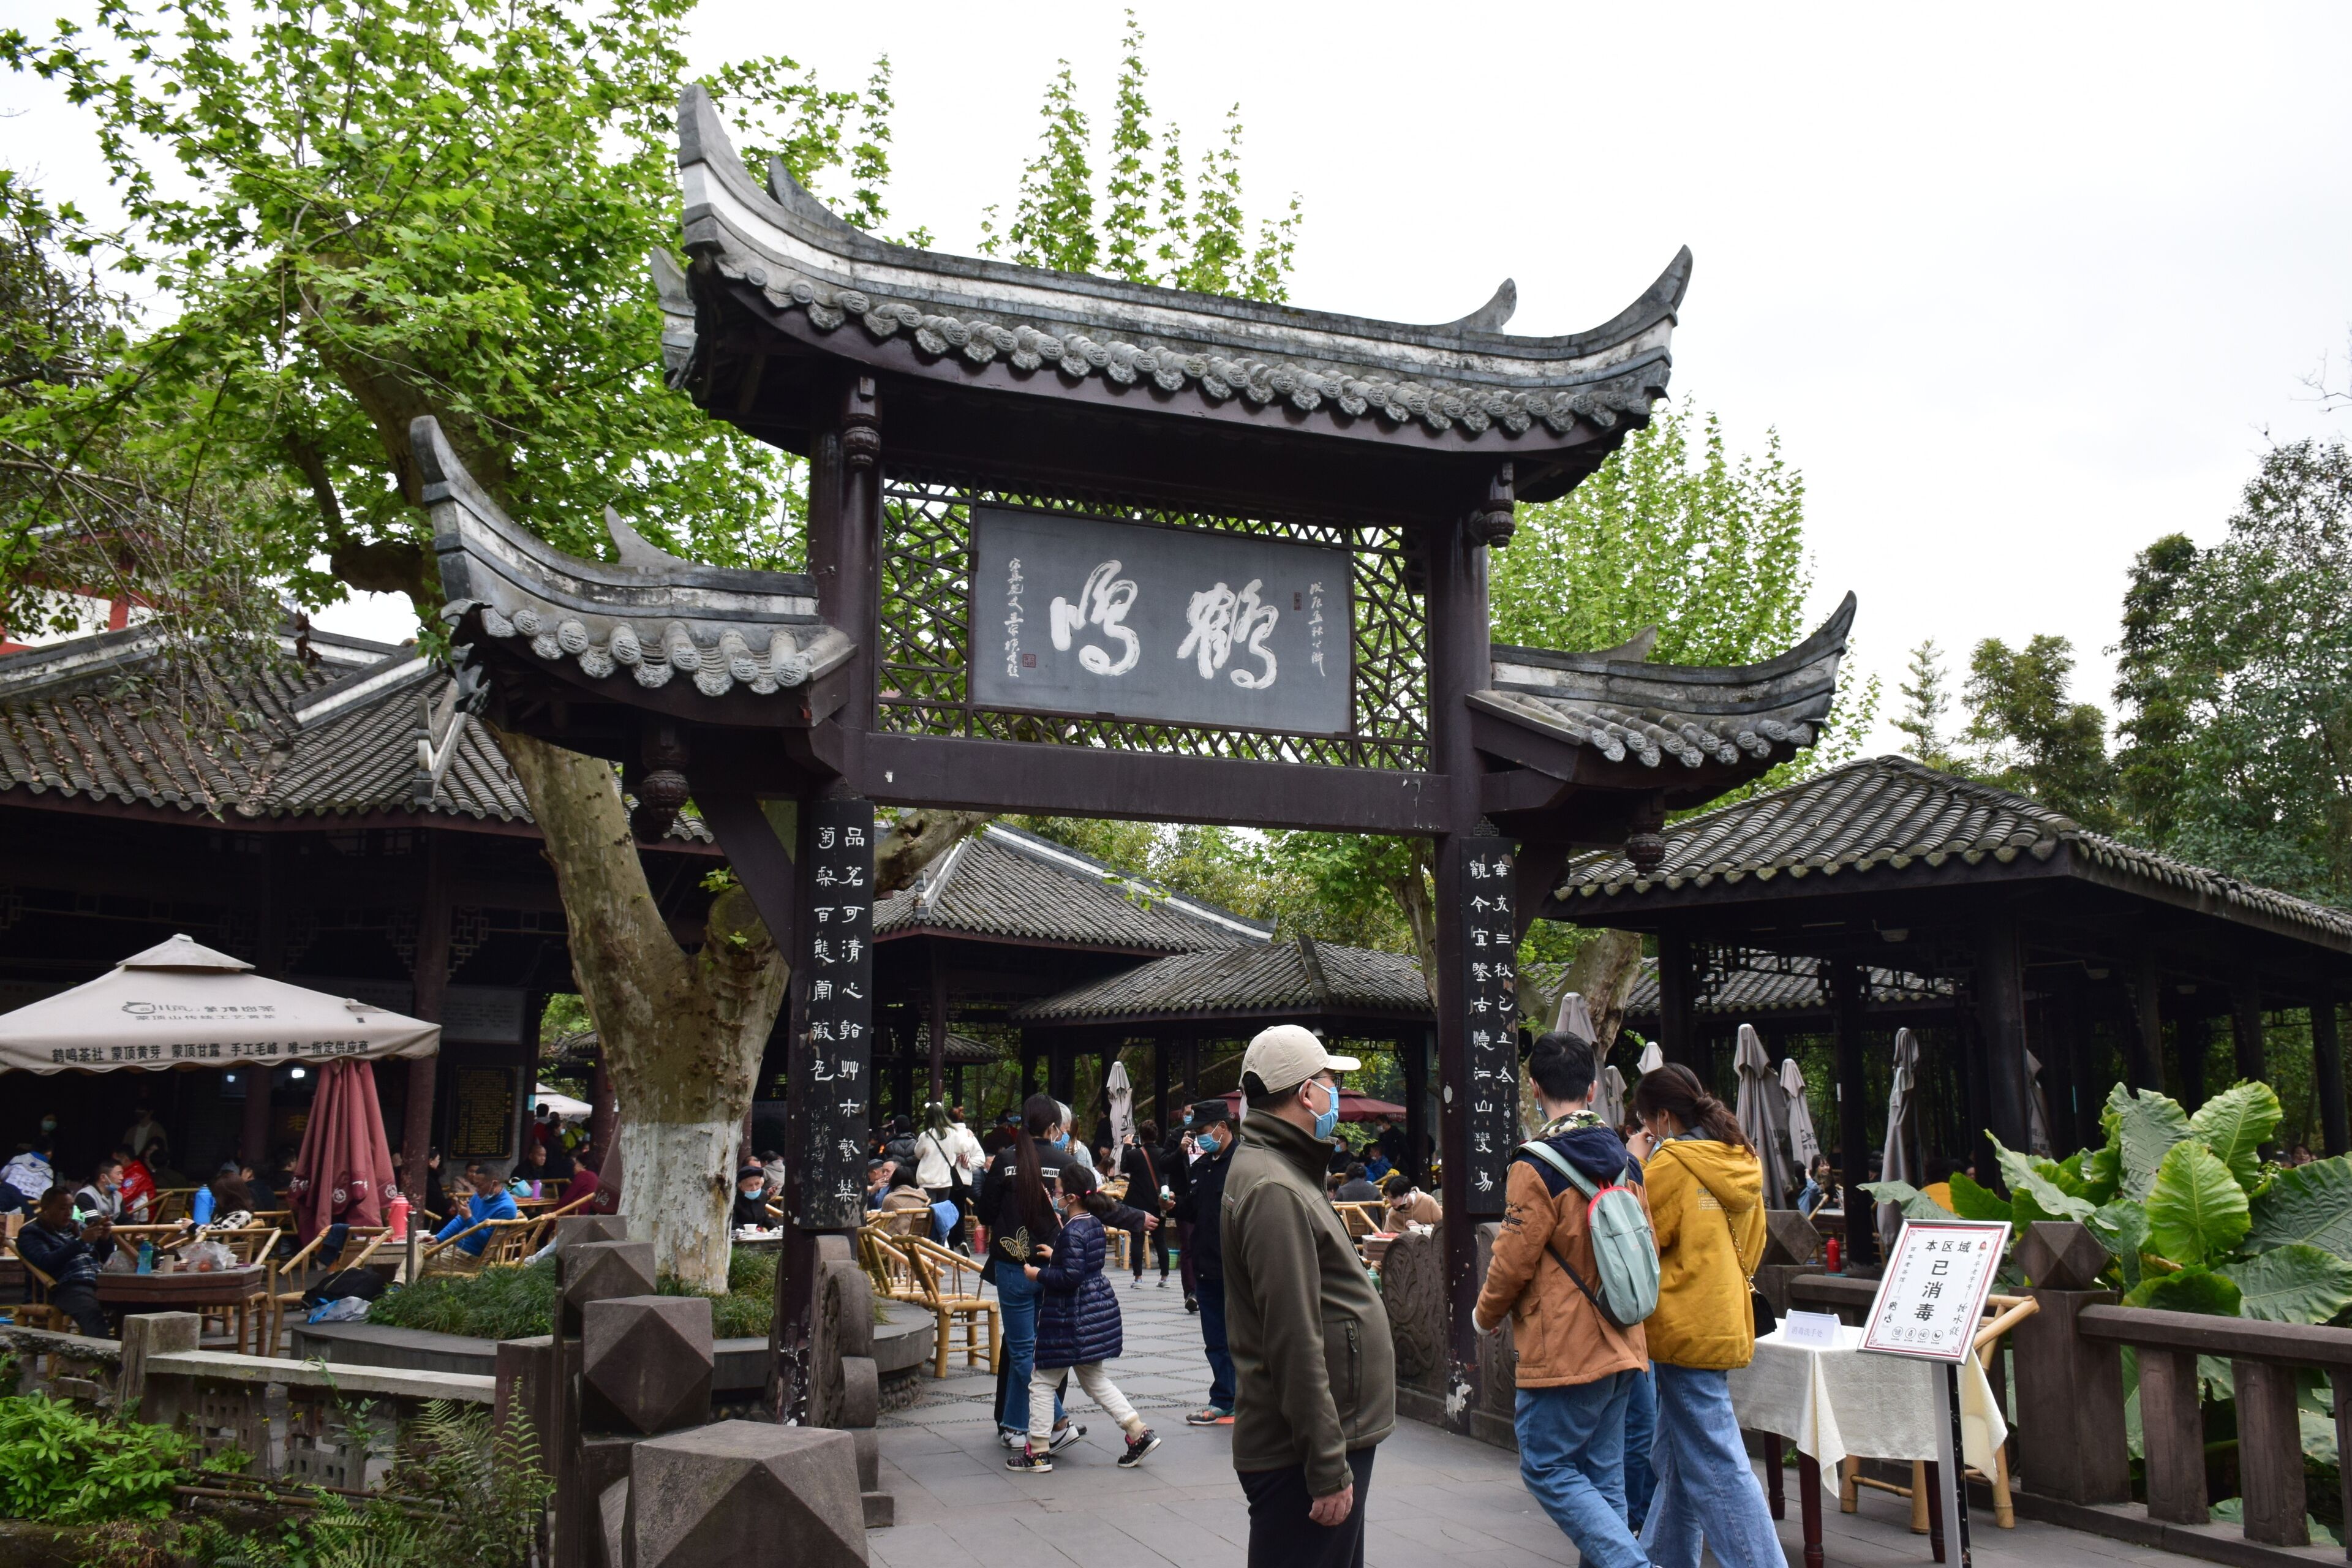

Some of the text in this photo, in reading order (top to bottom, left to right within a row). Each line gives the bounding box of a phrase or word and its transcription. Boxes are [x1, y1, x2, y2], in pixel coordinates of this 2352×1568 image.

[52, 1040, 369, 1063] 鹤鸣茶社 蒙顶黄芽 蒙顶甘露 手工毛峰 唯一指定供应商
[1925, 1240, 1972, 1253] 本区域
[1914, 1259, 1949, 1321] 已消毒
